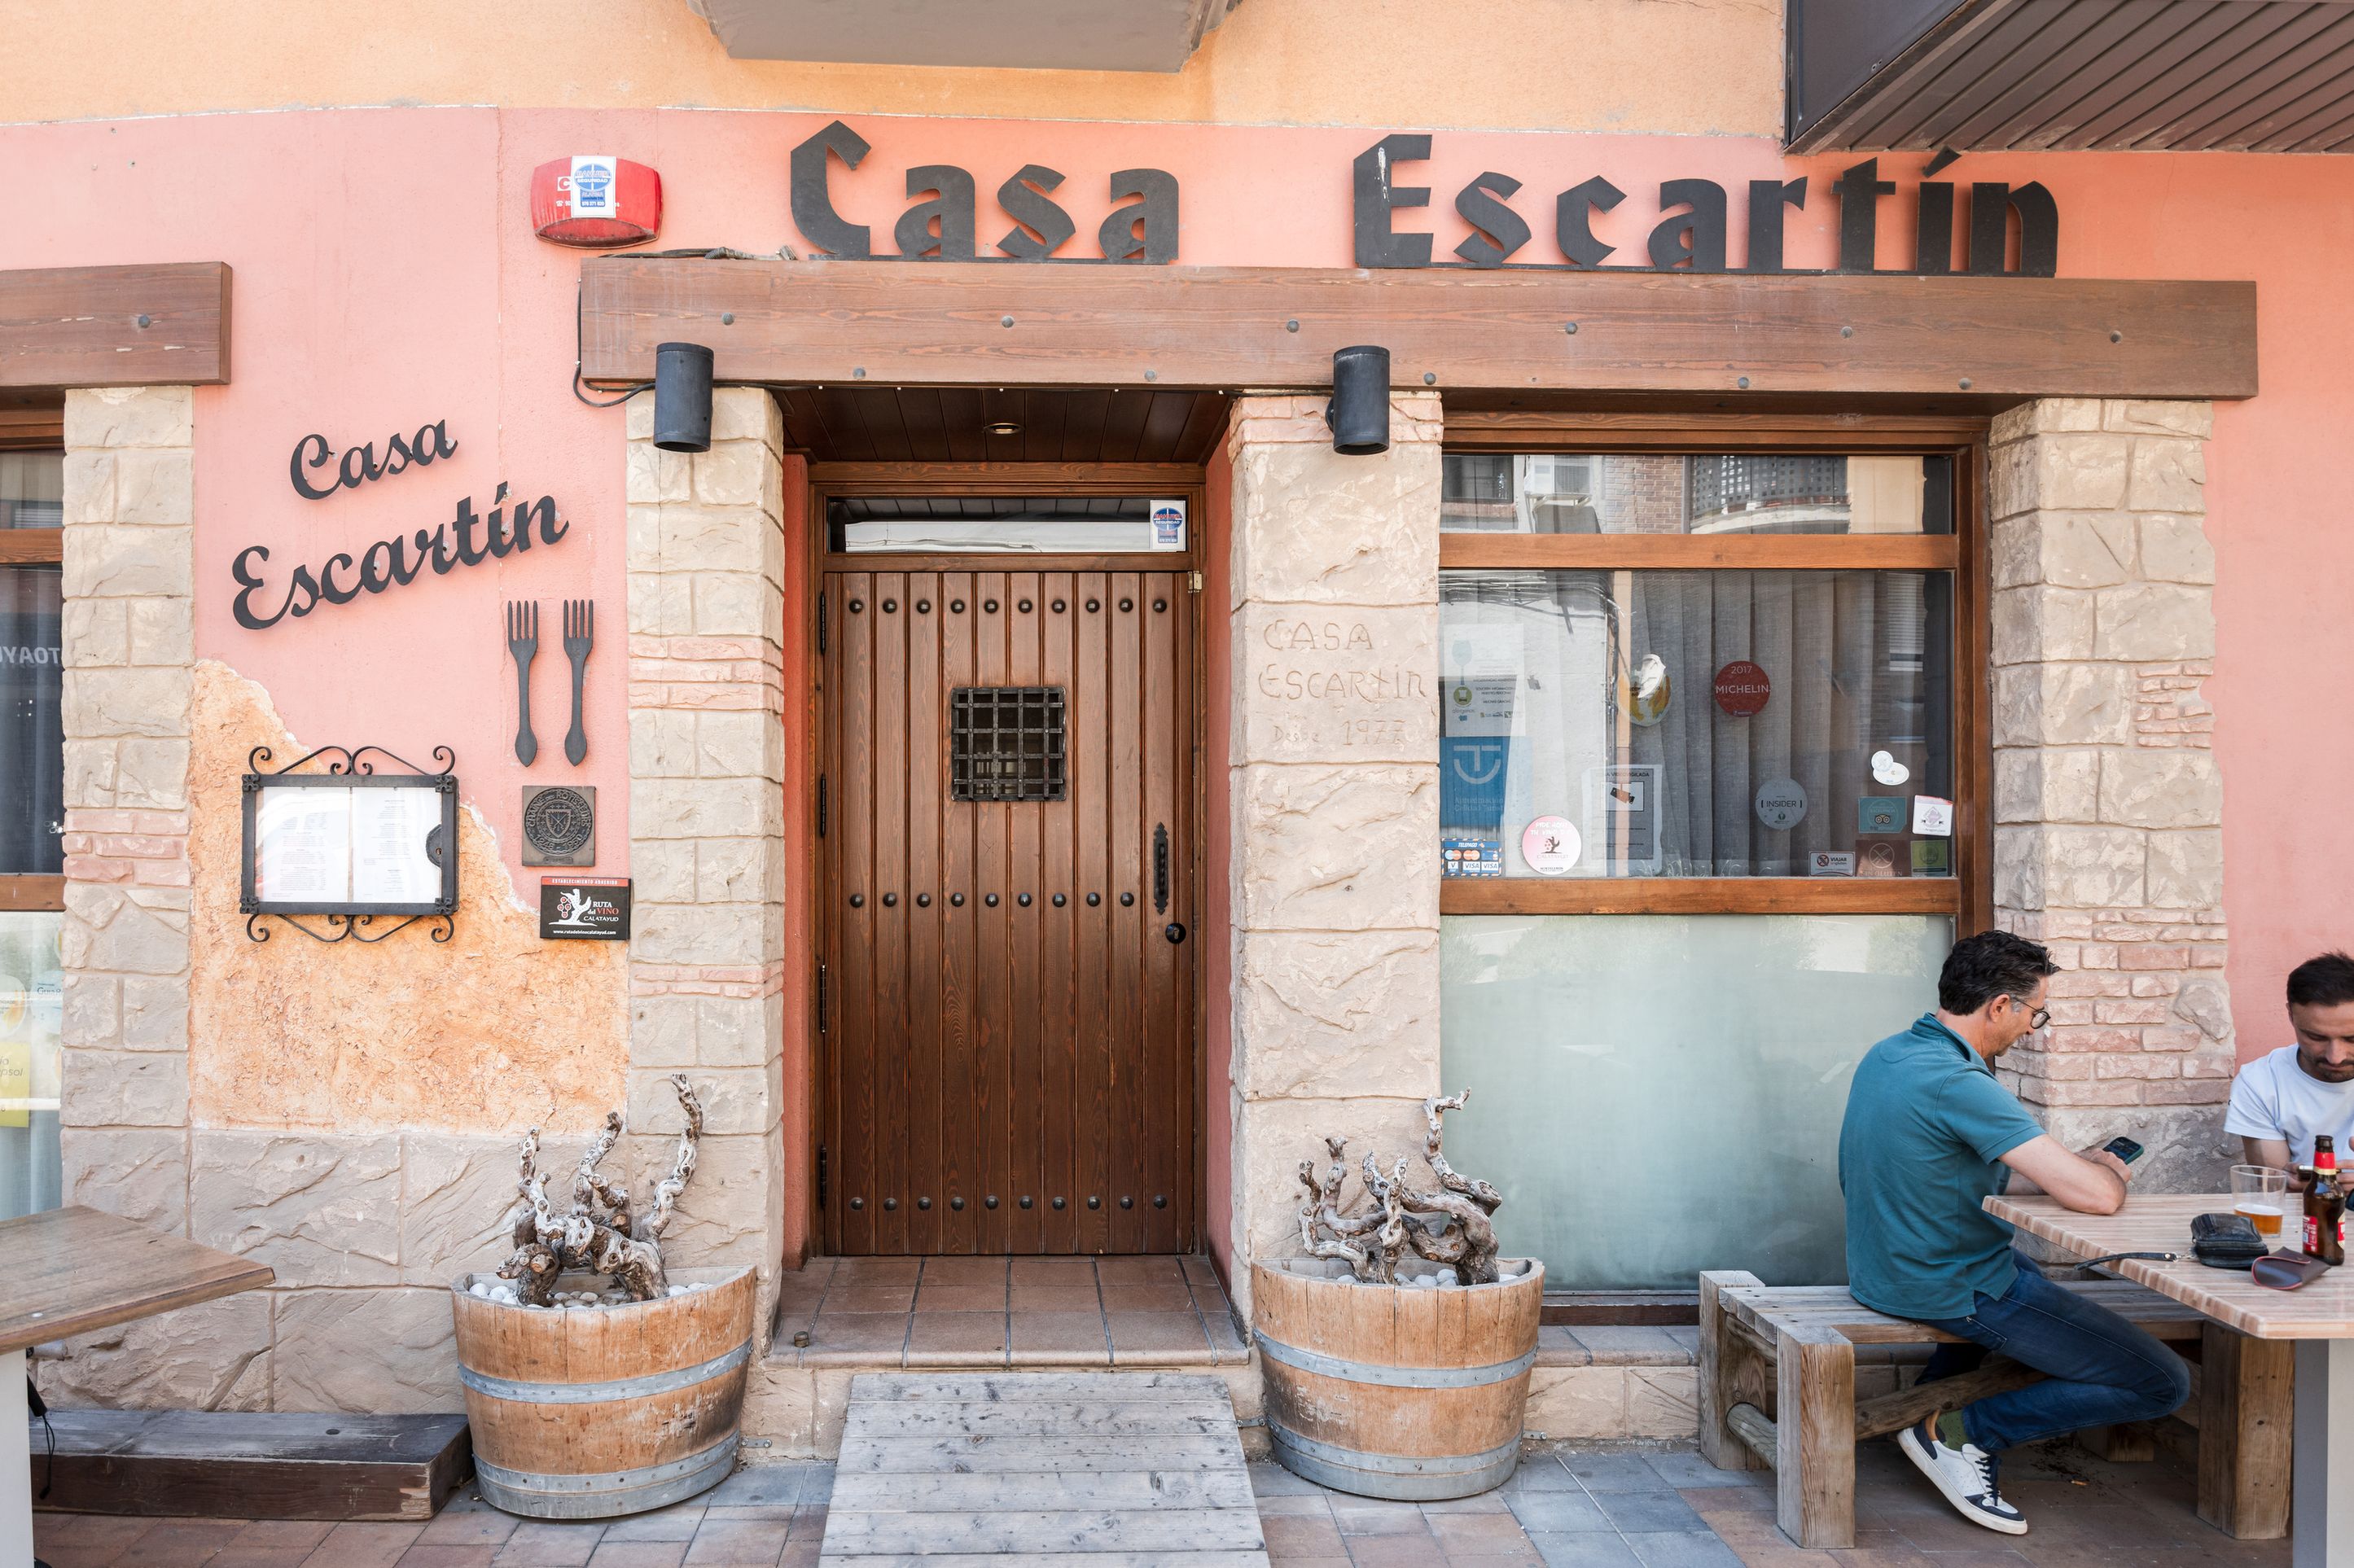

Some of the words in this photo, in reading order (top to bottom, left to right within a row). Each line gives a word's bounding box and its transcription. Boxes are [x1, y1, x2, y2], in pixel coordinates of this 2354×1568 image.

[790, 120, 1179, 265] Casa
[1353, 134, 2059, 278] Escartín
[290, 418, 458, 500] Casa
[231, 480, 570, 630] Escartín
[1264, 619, 1373, 650] CASA
[1731, 665, 1751, 674] 2017
[1716, 685, 1769, 694] MICHELIN
[1341, 719, 1406, 746] 1977
[597, 907, 619, 915] VINO
